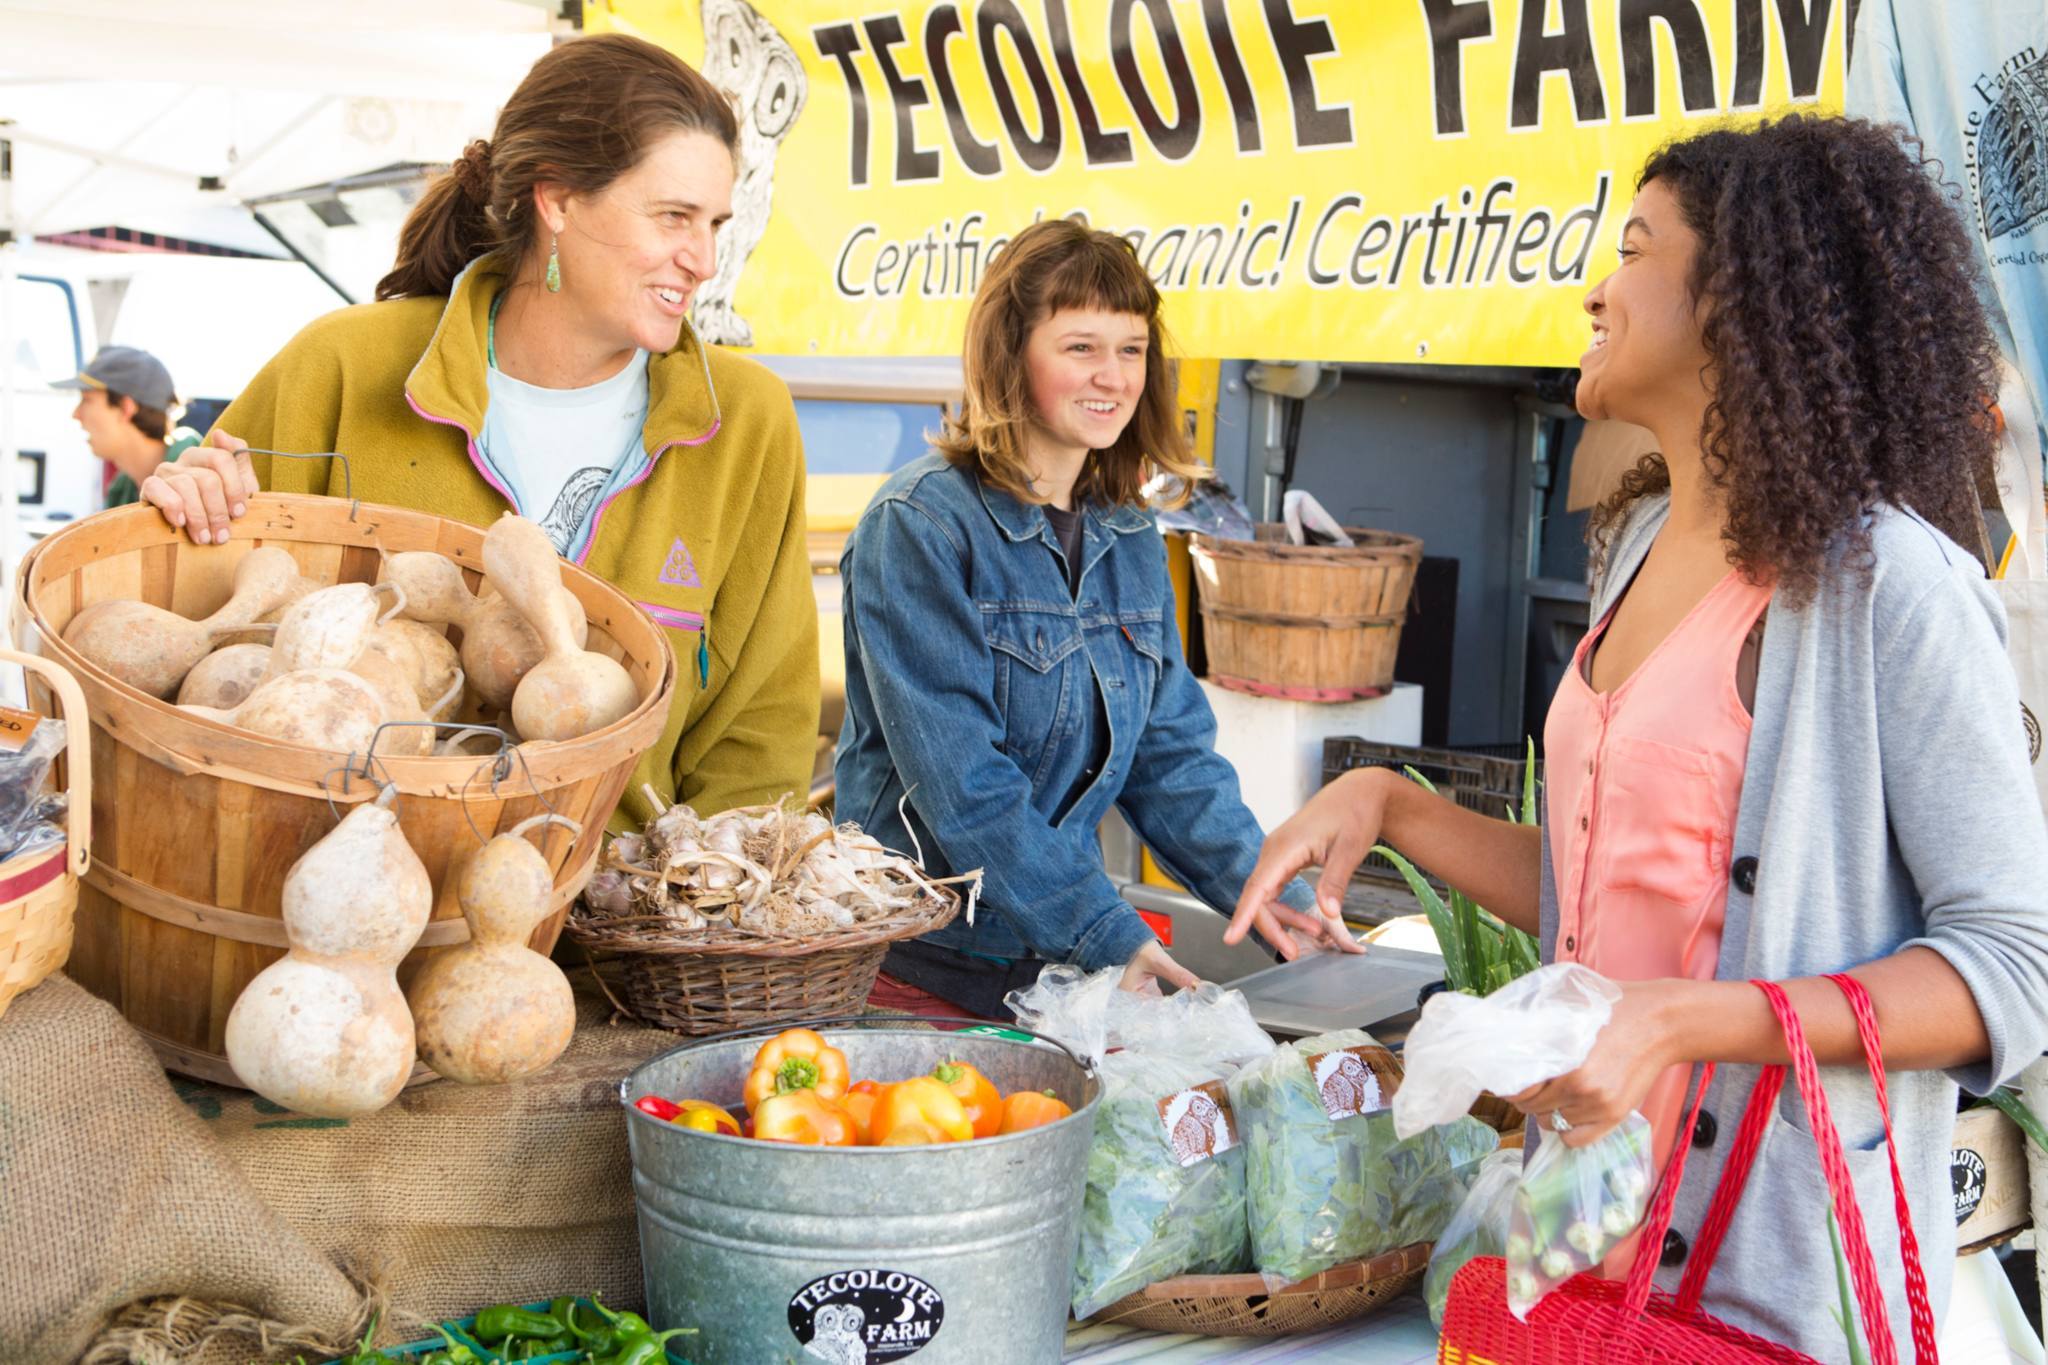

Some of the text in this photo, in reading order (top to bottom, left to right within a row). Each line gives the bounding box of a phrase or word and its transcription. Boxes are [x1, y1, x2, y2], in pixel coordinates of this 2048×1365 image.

[815, 0, 1353, 185] TECOLOTE
[1972, 46, 2037, 105] Farm
[838, 211, 1041, 296] Certifi
[1307, 176, 1608, 287] Certified
[1951, 1150, 1985, 1179] LOTE
[791, 1270, 940, 1314] TECOLOTE
[866, 1320, 931, 1343] FARM
